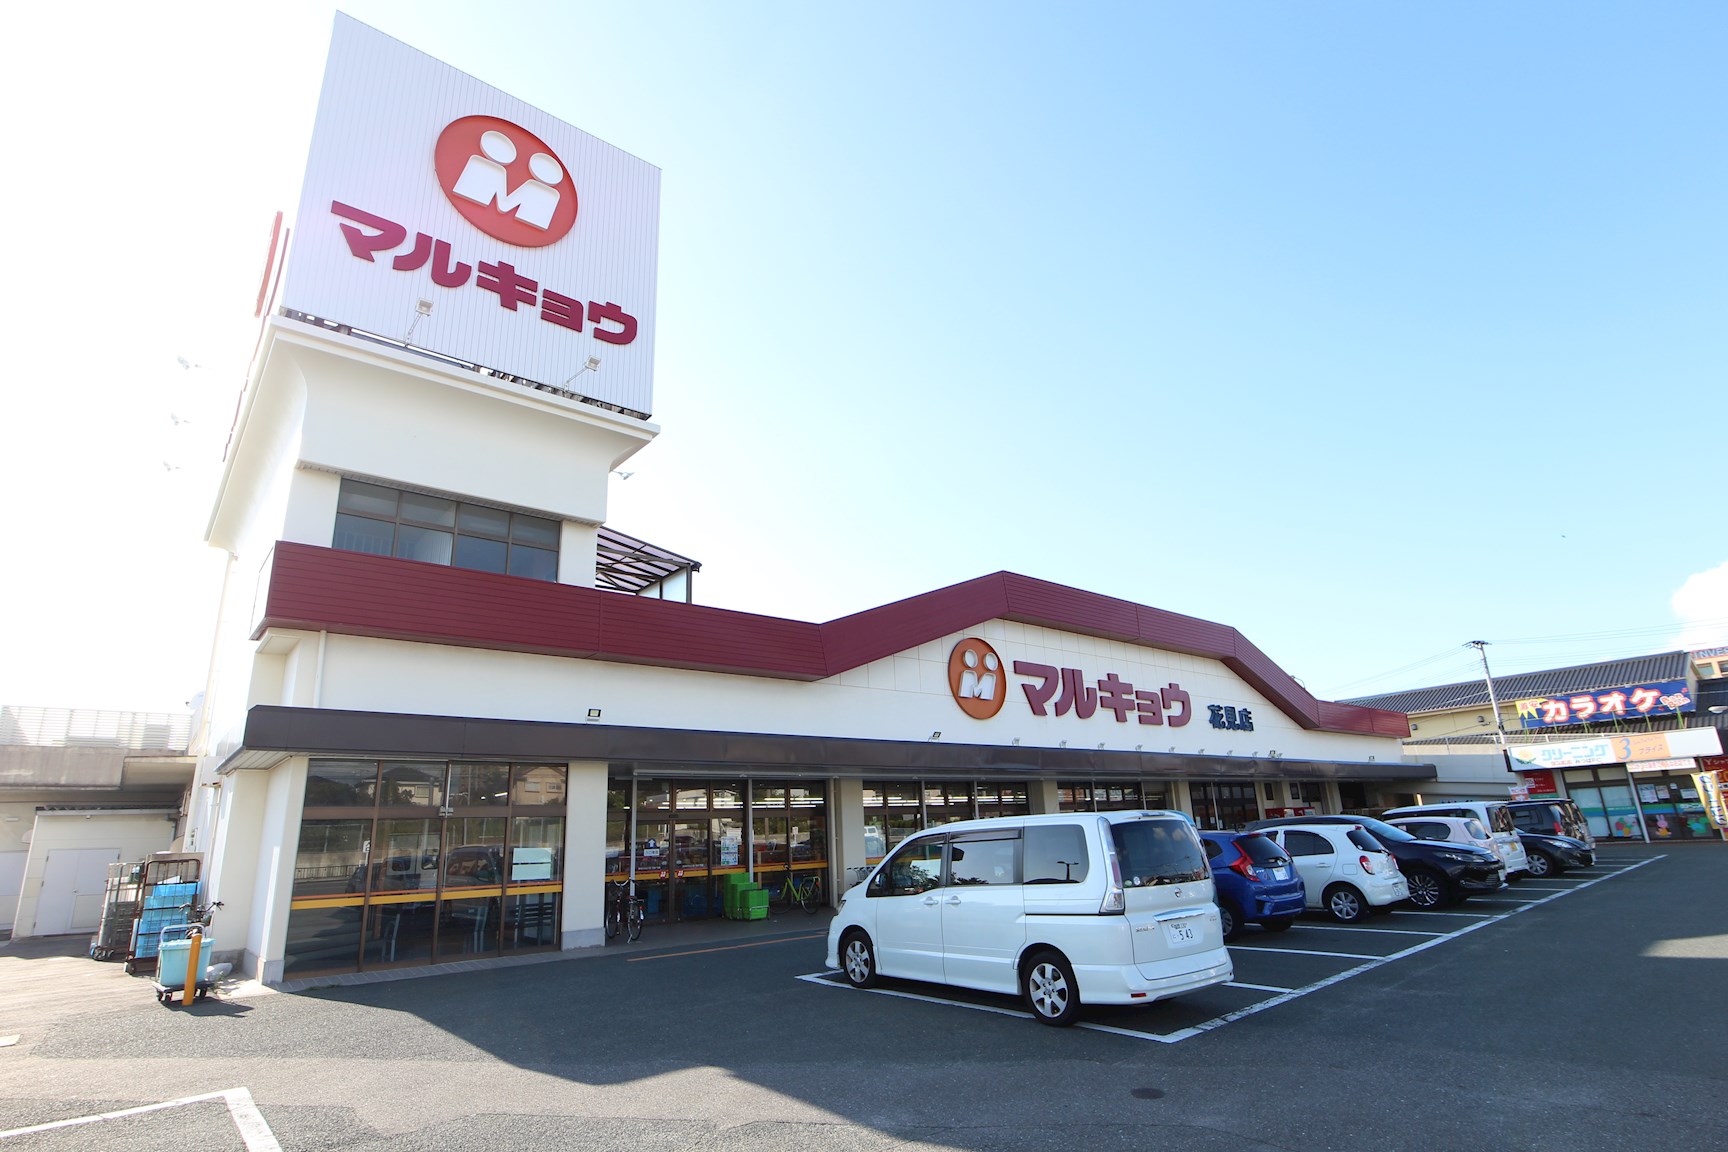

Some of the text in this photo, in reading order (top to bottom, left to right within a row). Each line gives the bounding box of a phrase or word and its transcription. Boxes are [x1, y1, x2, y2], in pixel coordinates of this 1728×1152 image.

[330, 199, 638, 345] マルキョウ
[1013, 660, 1192, 728] マルキョウ
[1541, 687, 1662, 724] カラオケ
[1207, 704, 1254, 732] 花見店
[1541, 744, 1609, 762] クリーニング
[1618, 737, 1632, 760] 3
